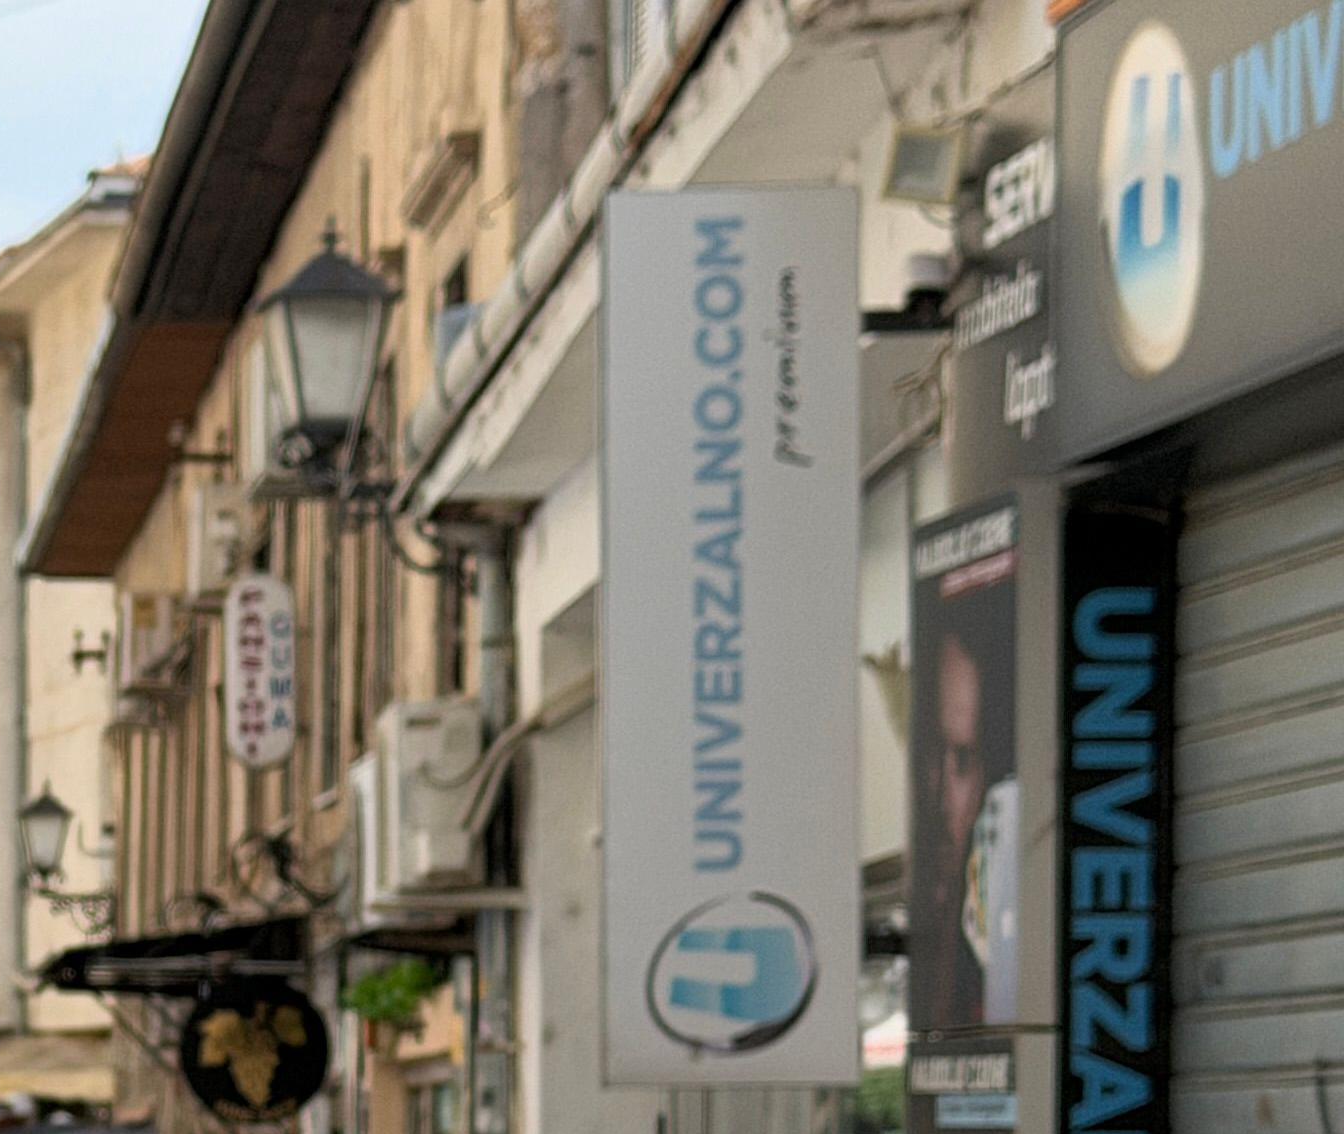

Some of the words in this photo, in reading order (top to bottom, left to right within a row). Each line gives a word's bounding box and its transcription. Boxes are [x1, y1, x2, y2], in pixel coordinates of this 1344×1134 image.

[1209, 0, 1344, 179] UNIV
[764, 264, 813, 468] premium
[692, 215, 745, 874] UNIVERZALNO.COM
